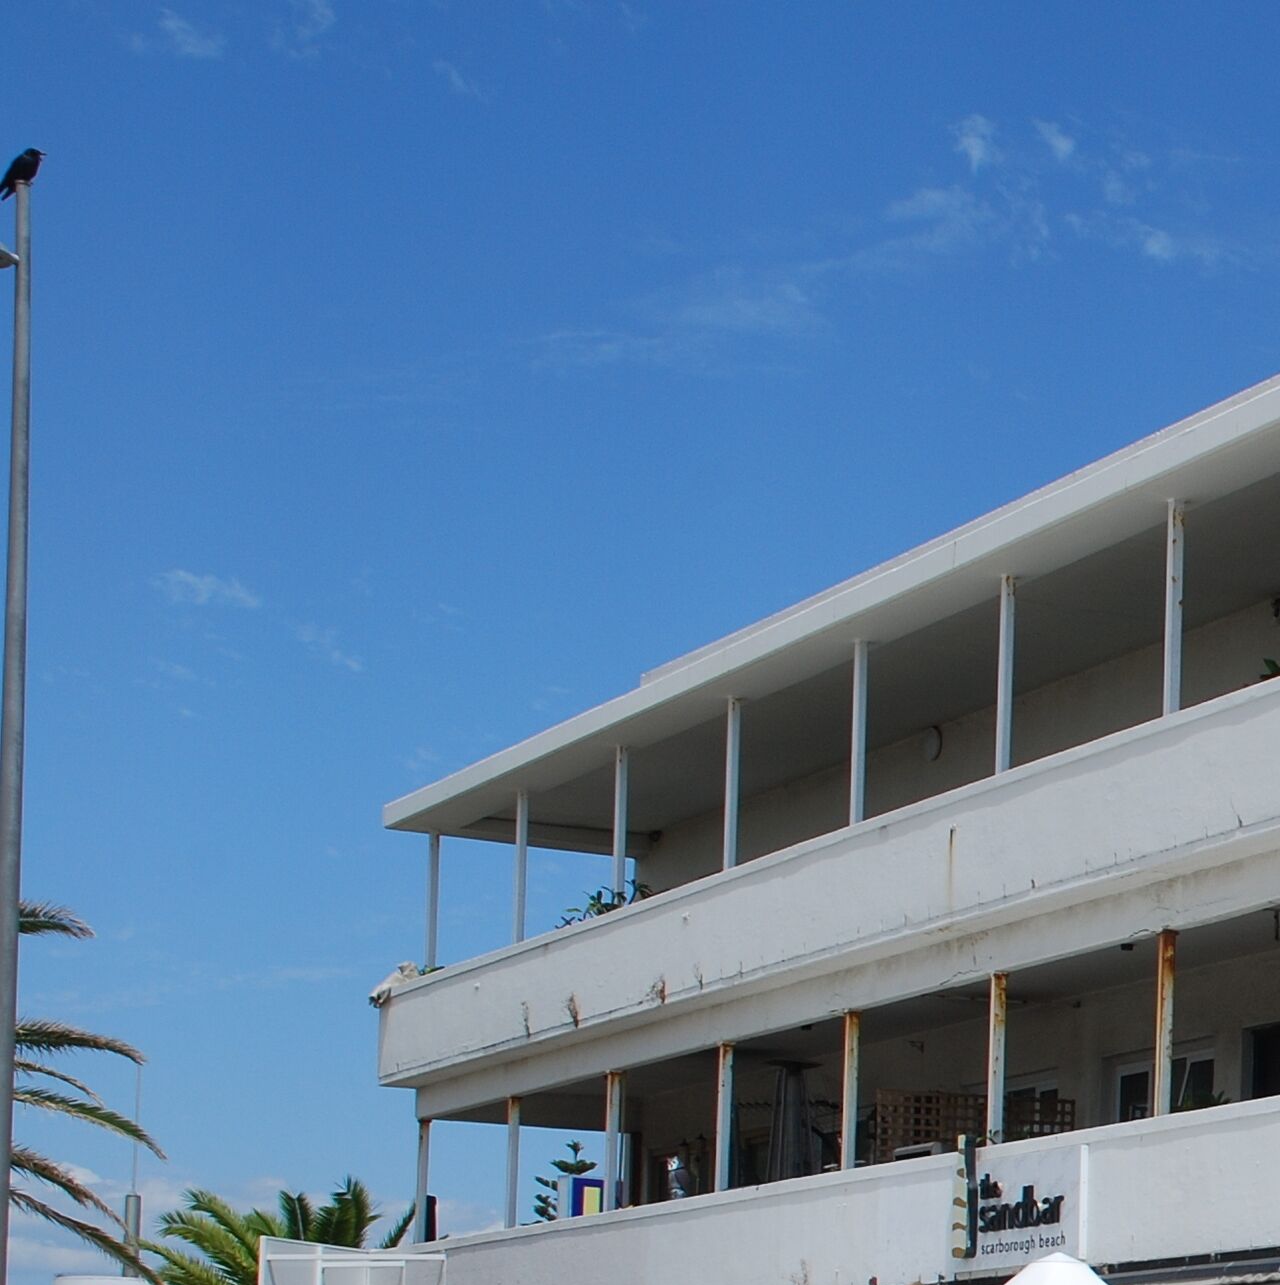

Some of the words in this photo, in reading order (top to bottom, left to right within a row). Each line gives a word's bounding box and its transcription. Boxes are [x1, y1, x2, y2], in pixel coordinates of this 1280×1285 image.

[979, 1185, 1065, 1234] sandbar
[981, 1234, 1036, 1255] scarborough
[1038, 1230, 1067, 1249] beach
